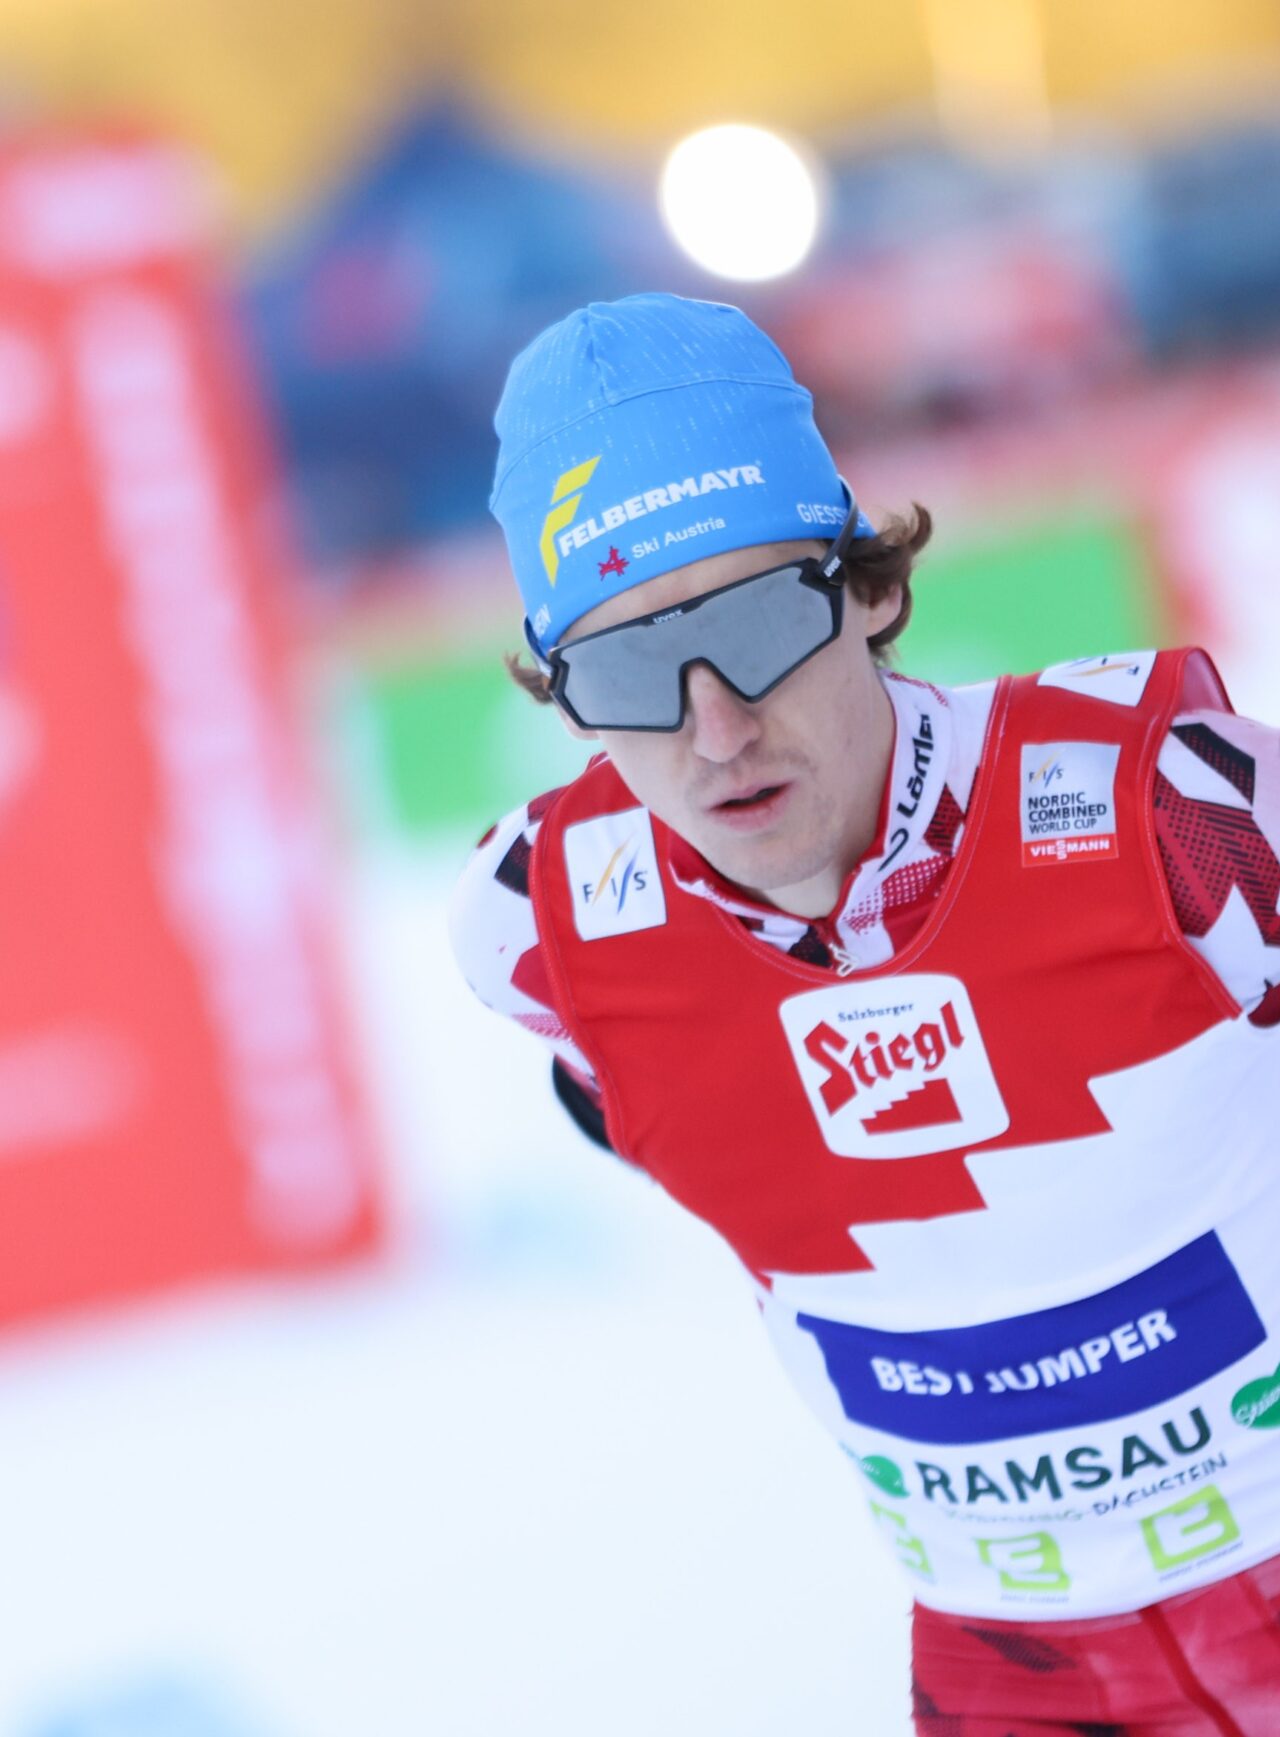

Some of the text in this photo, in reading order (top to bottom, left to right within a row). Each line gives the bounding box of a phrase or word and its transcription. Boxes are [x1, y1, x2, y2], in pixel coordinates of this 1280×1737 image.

[557, 464, 766, 558] FELBERMAYR
[631, 516, 727, 559] Ski Austria
[1028, 759, 1064, 785] FIS
[1027, 791, 1087, 810] NORDIC
[1028, 803, 1108, 823] COMBINED
[1029, 817, 1098, 835] WORLD CUP
[1029, 839, 1110, 860] VIESSMANN
[582, 860, 648, 908] FIS
[837, 1003, 914, 1022] Salzburger
[803, 1000, 965, 1118] Stiegl
[914, 1406, 1212, 1504] RAMSAU
